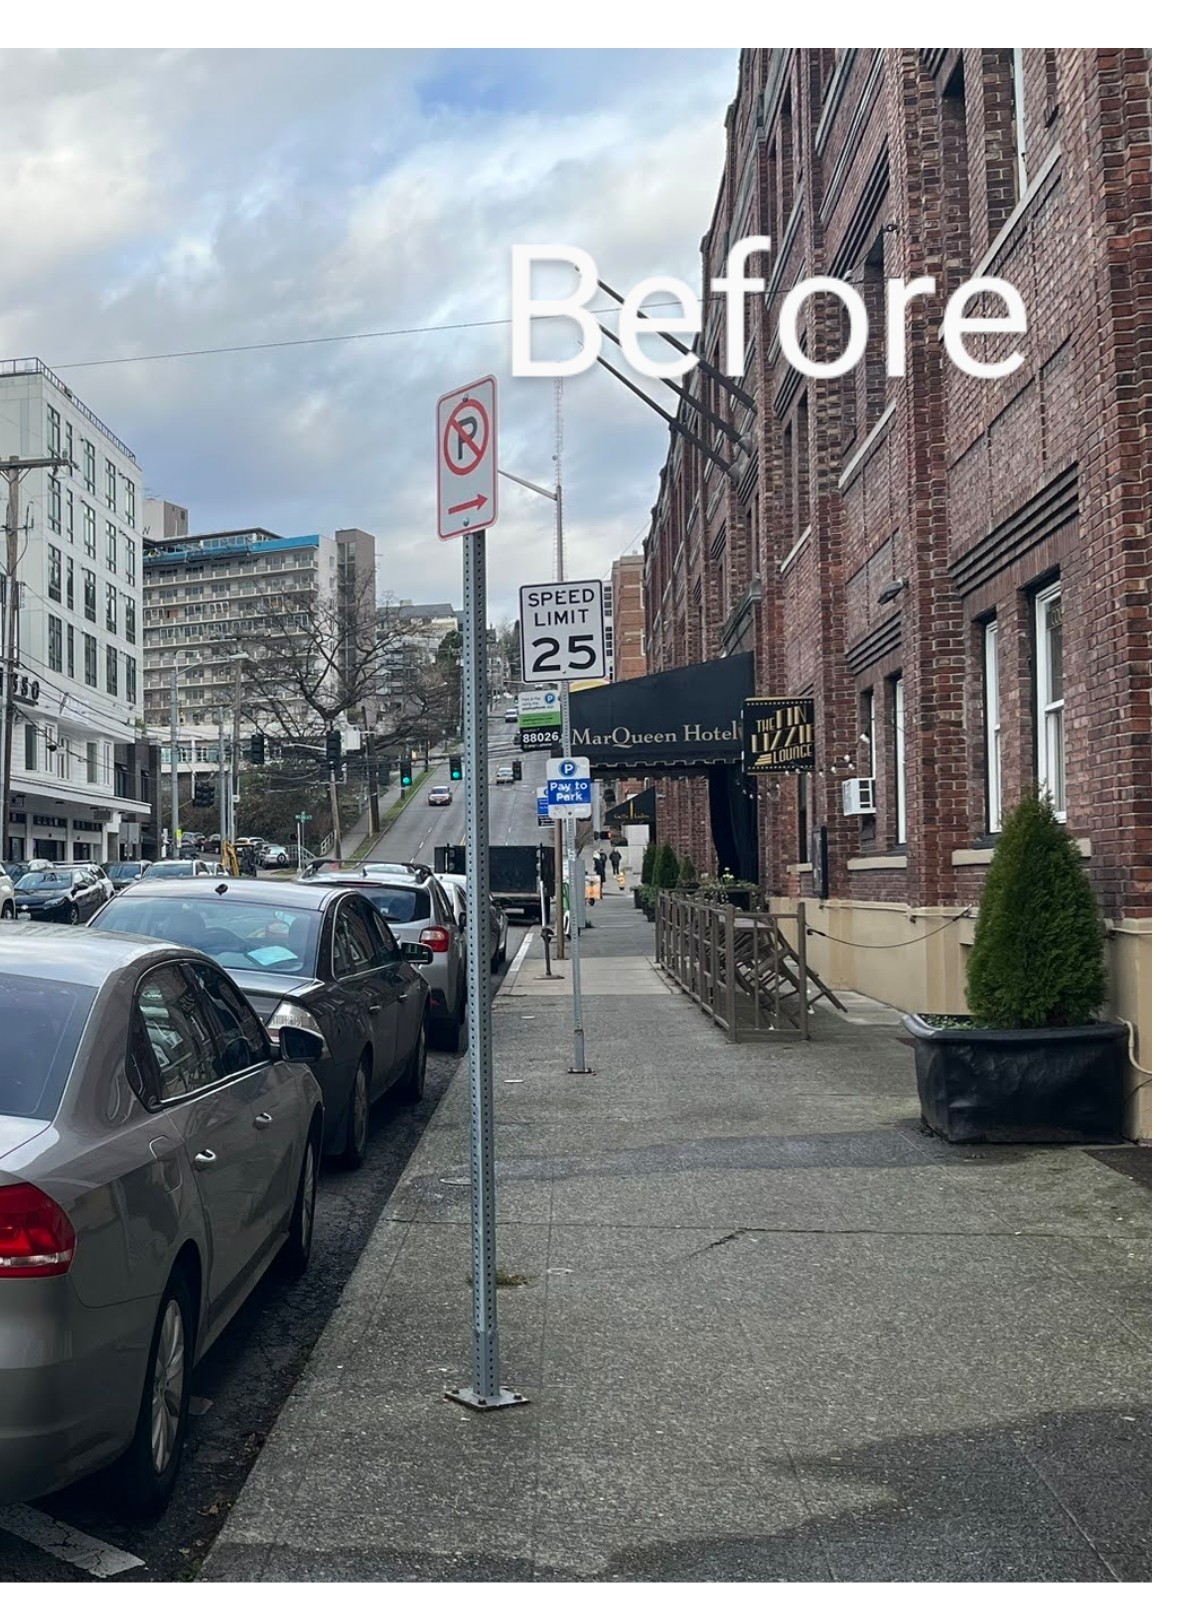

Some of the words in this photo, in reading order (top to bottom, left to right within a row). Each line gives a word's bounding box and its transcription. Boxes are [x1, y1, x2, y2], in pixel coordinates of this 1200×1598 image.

[528, 588, 594, 607] SPEED
[534, 608, 589, 627] LIMIT
[531, 634, 596, 673] 25
[571, 726, 676, 748] MarQueen
[683, 720, 738, 741] Hotel
[756, 717, 775, 733] THE
[522, 731, 559, 743] 88026
[773, 744, 813, 764] LOUNGE
[550, 782, 571, 792] Pay
[575, 781, 587, 789] to
[556, 792, 582, 801] Park
